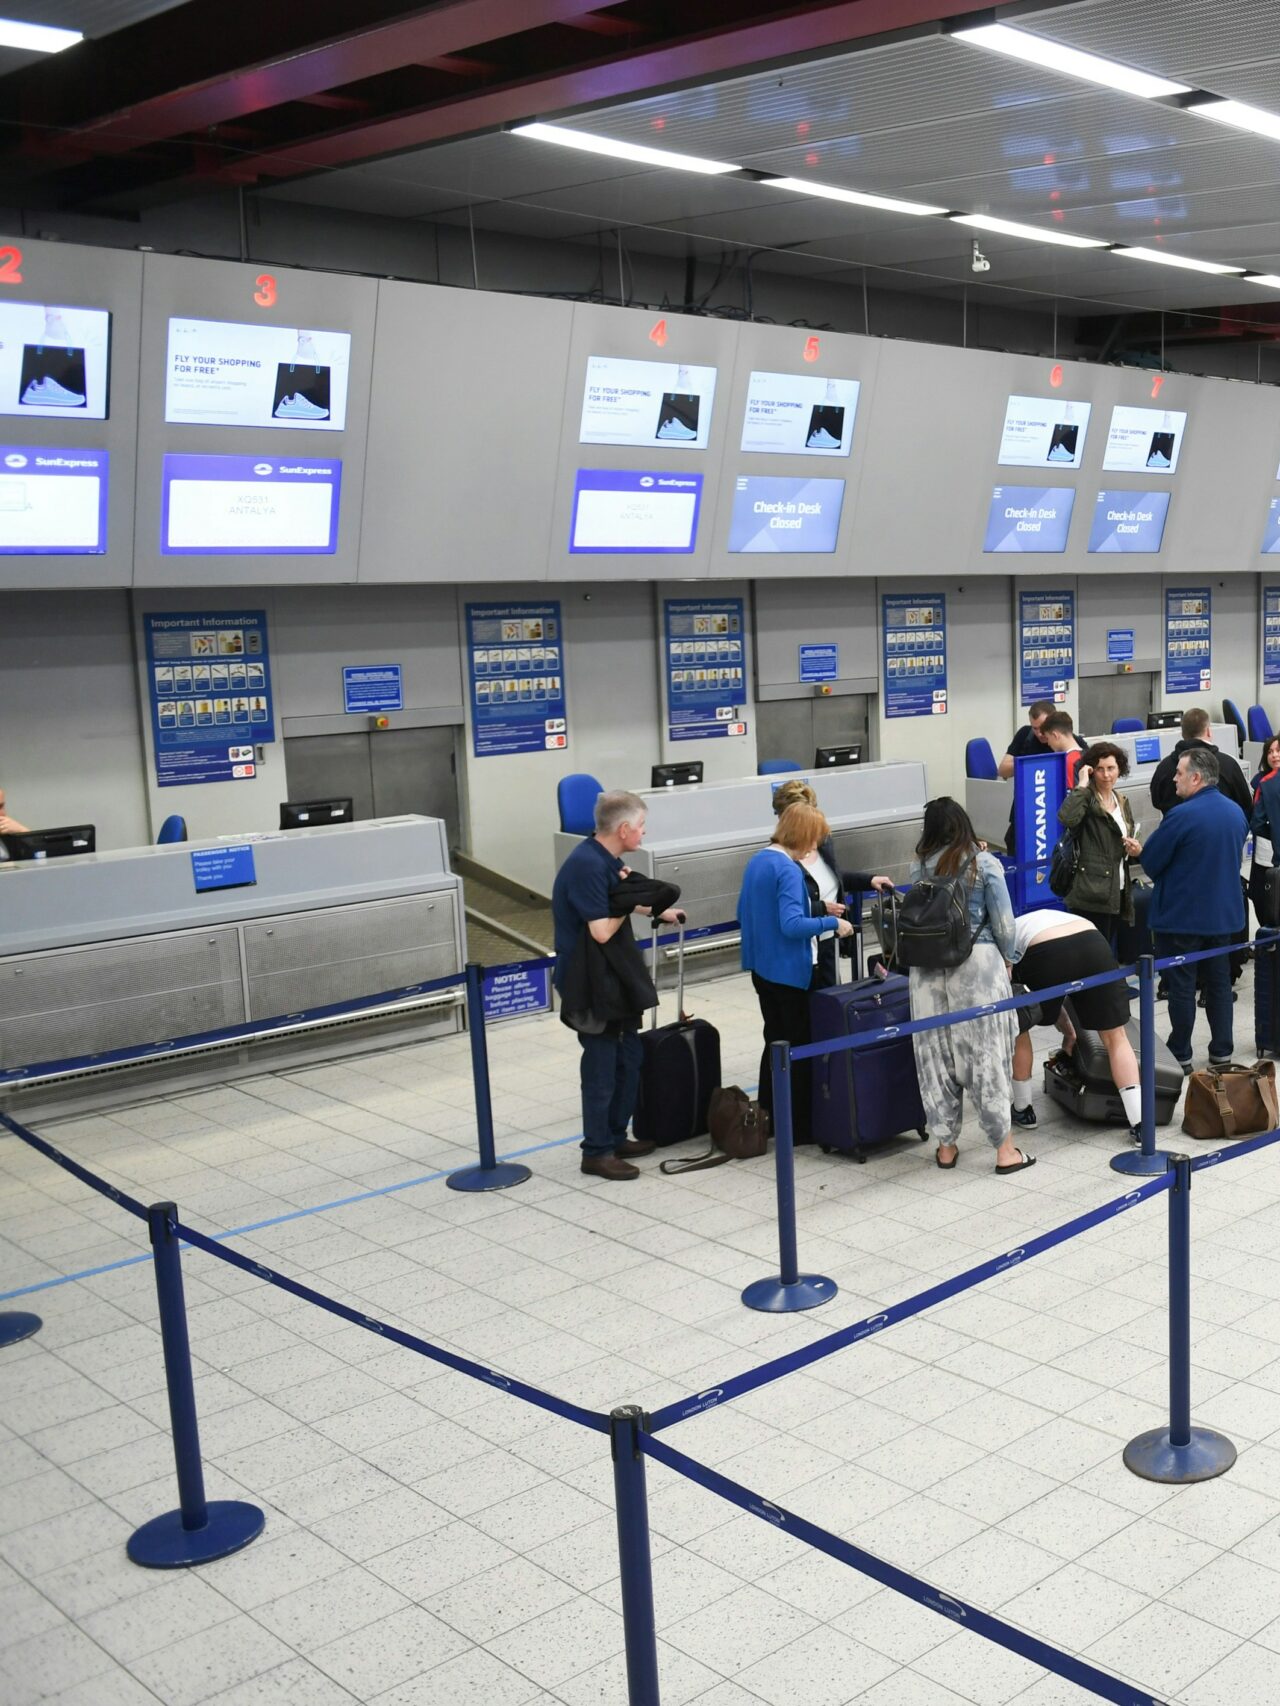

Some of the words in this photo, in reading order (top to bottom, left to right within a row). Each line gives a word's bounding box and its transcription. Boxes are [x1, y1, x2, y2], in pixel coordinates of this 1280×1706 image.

[0, 246, 23, 283] 2
[254, 274, 277, 307] 3
[649, 320, 668, 347] 4
[803, 336, 820, 362] 5
[174, 354, 190, 363] FLY
[193, 356, 216, 365] YOUR
[218, 358, 262, 368] SHOPPING
[174, 364, 192, 373] FOR
[1050, 365, 1063, 388] 6
[1152, 376, 1164, 398] 7
[35, 457, 99, 469] SunExpress
[279, 465, 332, 476] SunExpress
[658, 478, 697, 488] SunExpress
[229, 506, 276, 516] ANTALYA
[753, 501, 795, 514] Check-in
[797, 502, 821, 514] Desk
[1005, 507, 1037, 518] Check-in
[1038, 508, 1056, 519] Desk
[1107, 510, 1135, 520] Check-in
[1136, 511, 1153, 521] Desk
[770, 517, 802, 529] Closed
[1016, 521, 1041, 532] Closed
[1117, 523, 1139, 533] Closed
[471, 608, 510, 617] Important
[511, 606, 554, 615] Information
[669, 603, 700, 612] Important
[701, 602, 738, 611] Information
[152, 618, 199, 629] Important
[202, 616, 258, 626] Information
[494, 971, 528, 985] NOTICE
[853, 1329, 870, 1339] LONDON
[870, 1322, 883, 1332] LUTON
[682, 1404, 702, 1417] LONDON
[702, 1397, 718, 1408] LUTON
[923, 1595, 943, 1610] LONDON
[943, 1606, 960, 1619] LUTON
